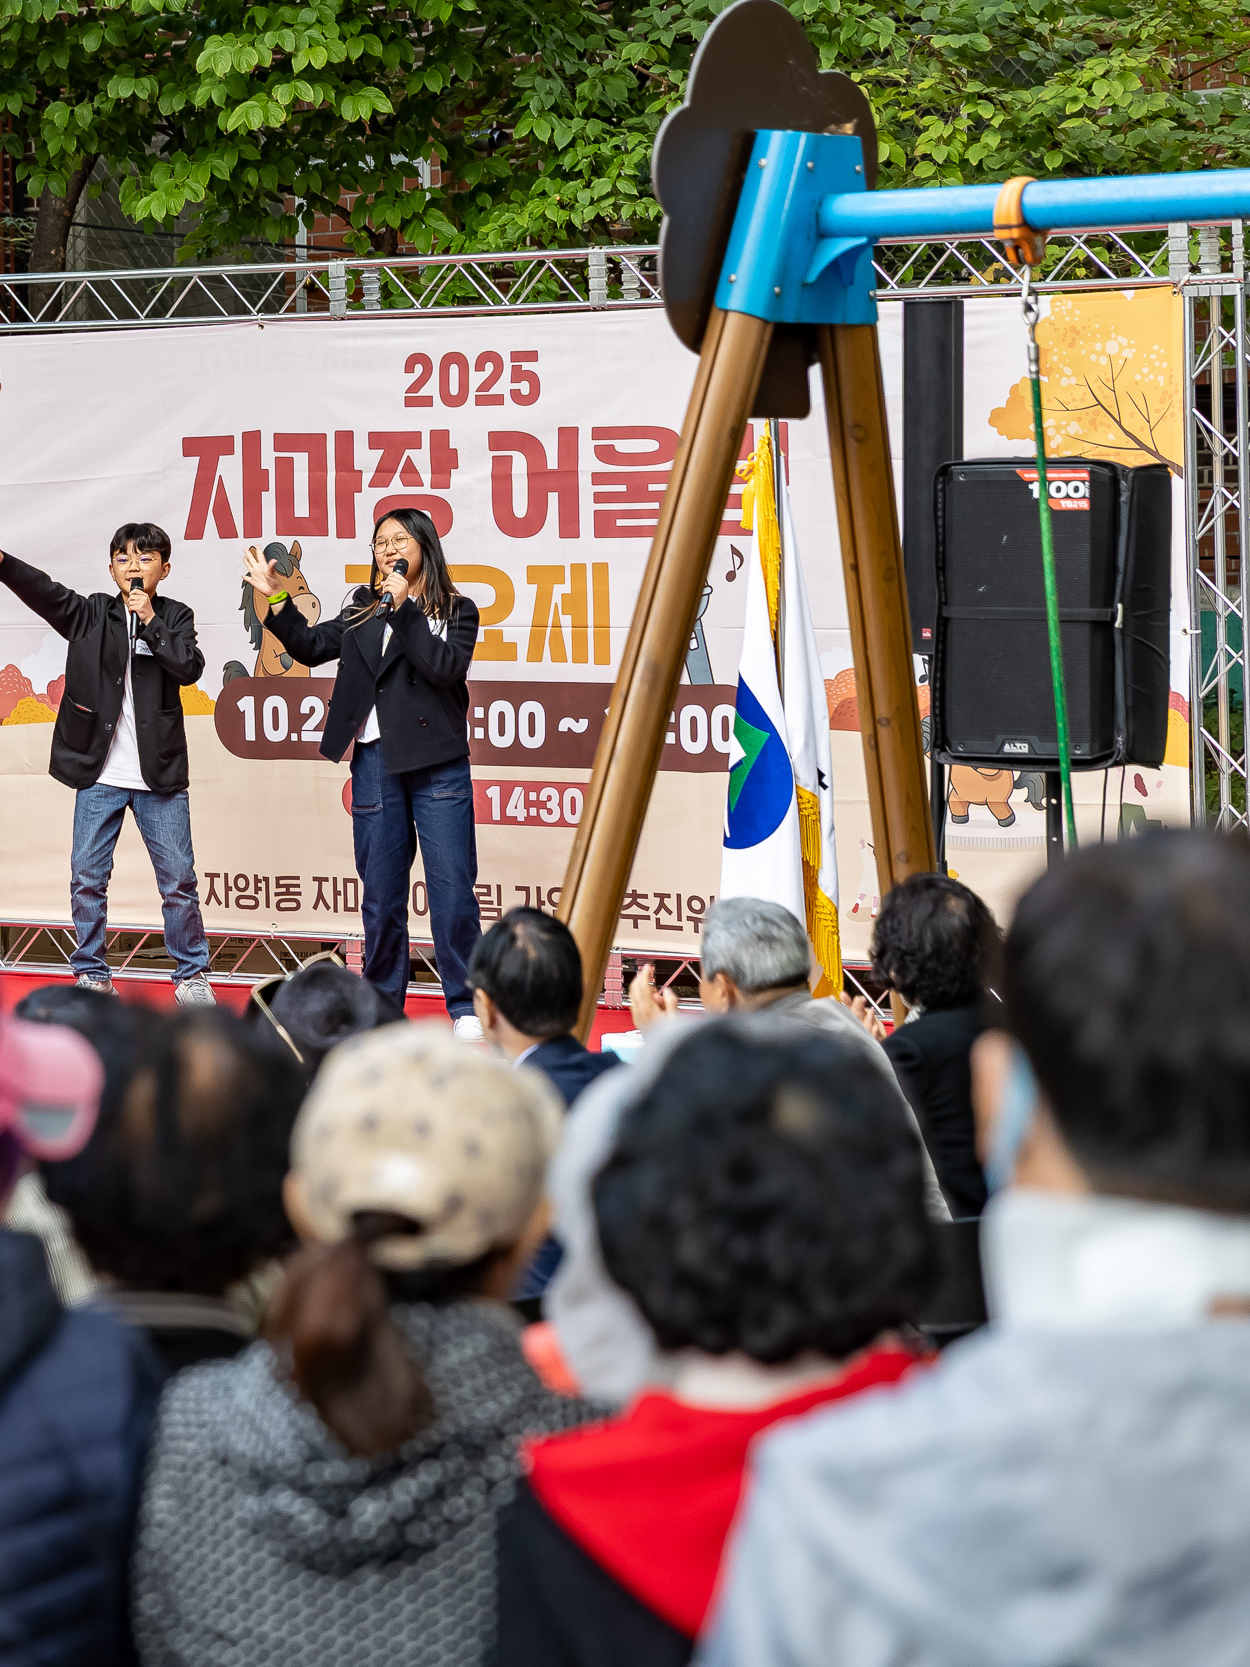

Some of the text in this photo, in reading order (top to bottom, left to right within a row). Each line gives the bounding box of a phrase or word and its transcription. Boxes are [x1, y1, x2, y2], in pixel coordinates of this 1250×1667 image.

[404, 350, 541, 408] 2025
[181, 428, 460, 541] 자마장
[1028, 480, 1085, 499] 100
[236, 694, 324, 743] 10.2
[1003, 742, 1029, 753] ALTO
[485, 785, 584, 824] 14:30
[204, 872, 302, 912] 자양1동
[619, 889, 715, 934] 추진위
